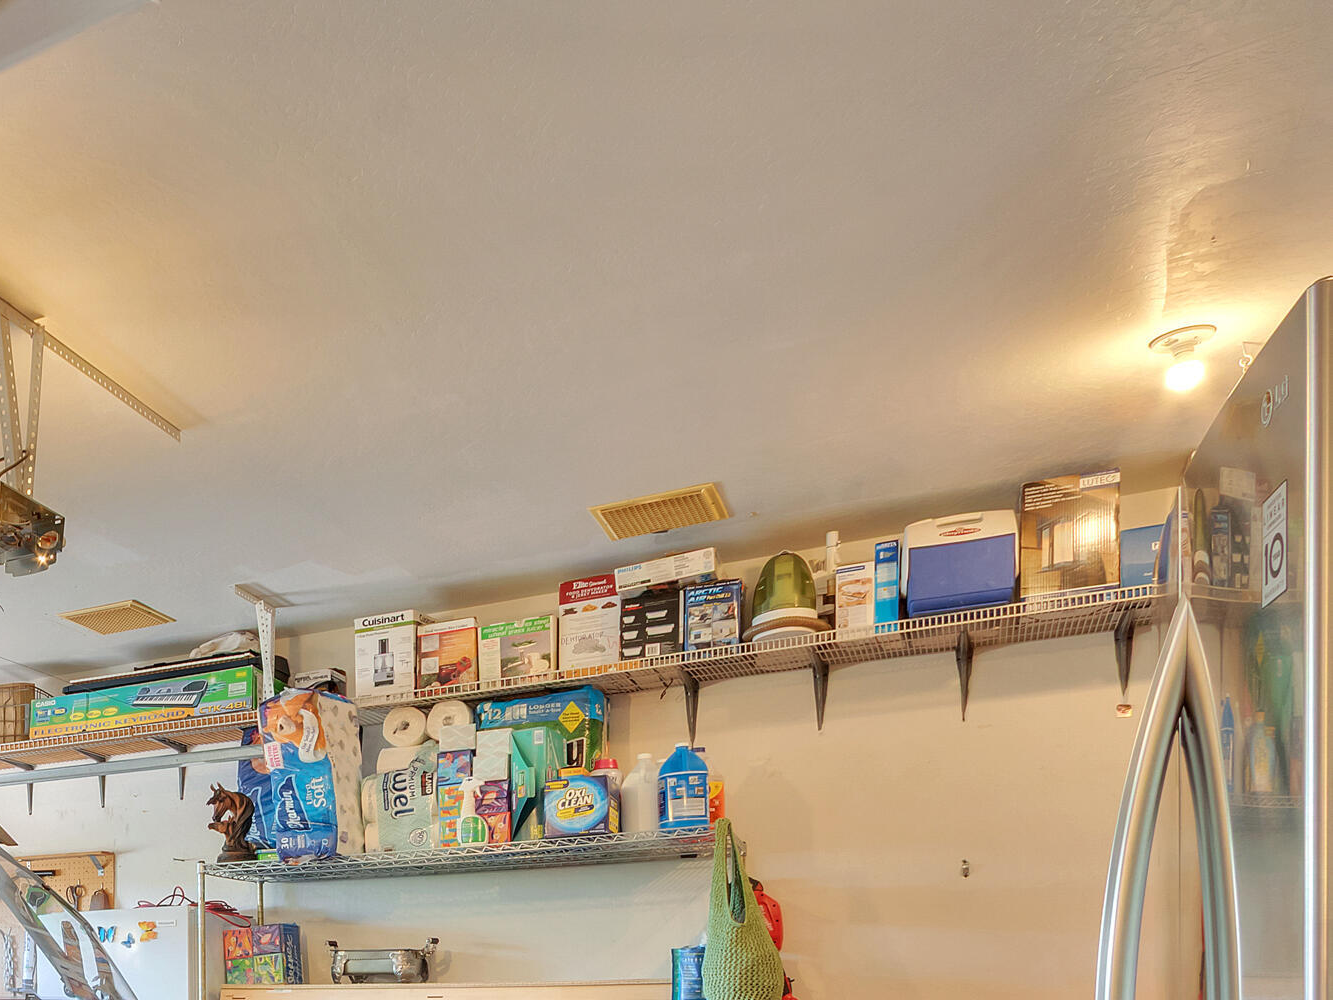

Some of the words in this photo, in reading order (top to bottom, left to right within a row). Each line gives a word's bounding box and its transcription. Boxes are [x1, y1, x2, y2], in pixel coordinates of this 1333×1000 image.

[1264, 532, 1284, 587] 10
[688, 586, 724, 597] ARCTIC
[362, 613, 405, 627] Cuisinart
[35, 699, 56, 708] CASIO
[34, 719, 112, 736] ELECTRONIC
[113, 710, 186, 727] KEYBOARD
[311, 776, 327, 808] Soft
[392, 770, 415, 817] wel
[565, 787, 587, 800] OXI
[282, 790, 304, 830] Charmin
[557, 794, 594, 811] CLEAN
[281, 837, 289, 849] 30
